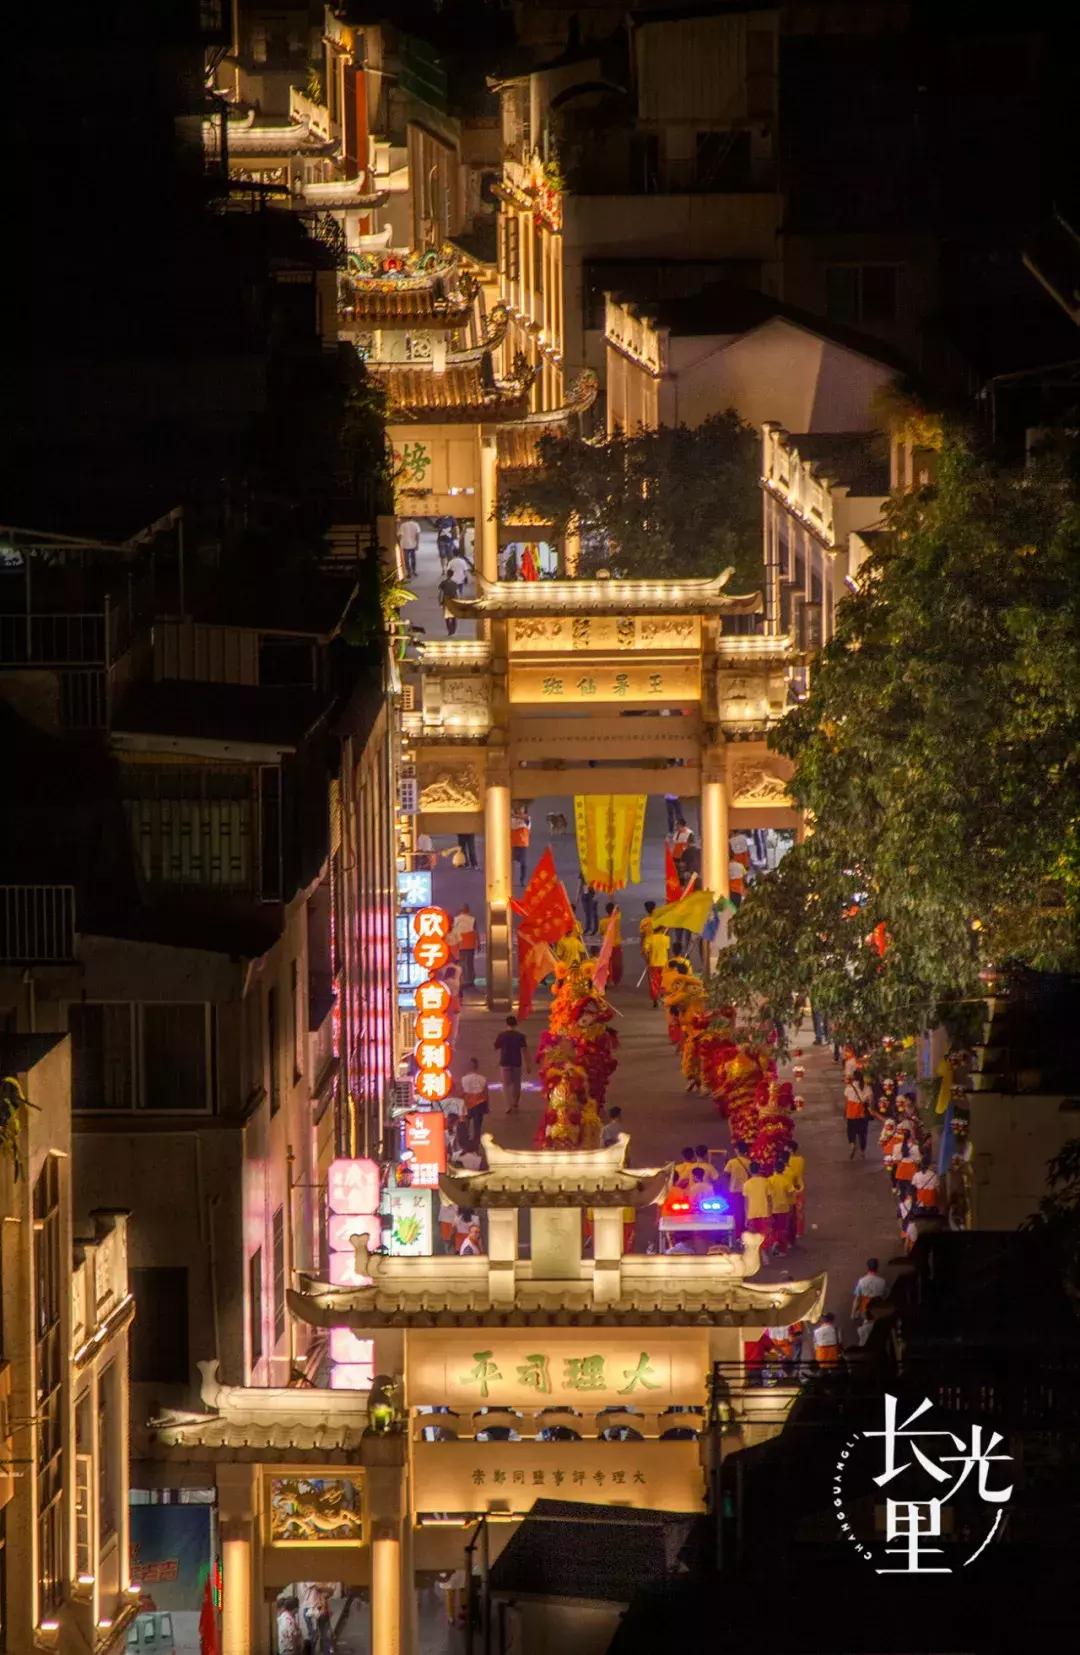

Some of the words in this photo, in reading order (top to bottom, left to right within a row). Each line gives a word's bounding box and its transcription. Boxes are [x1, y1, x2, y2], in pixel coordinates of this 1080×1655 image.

[420, 984, 447, 1097] 吉吉利利
[459, 1350, 663, 1398] 大理司平
